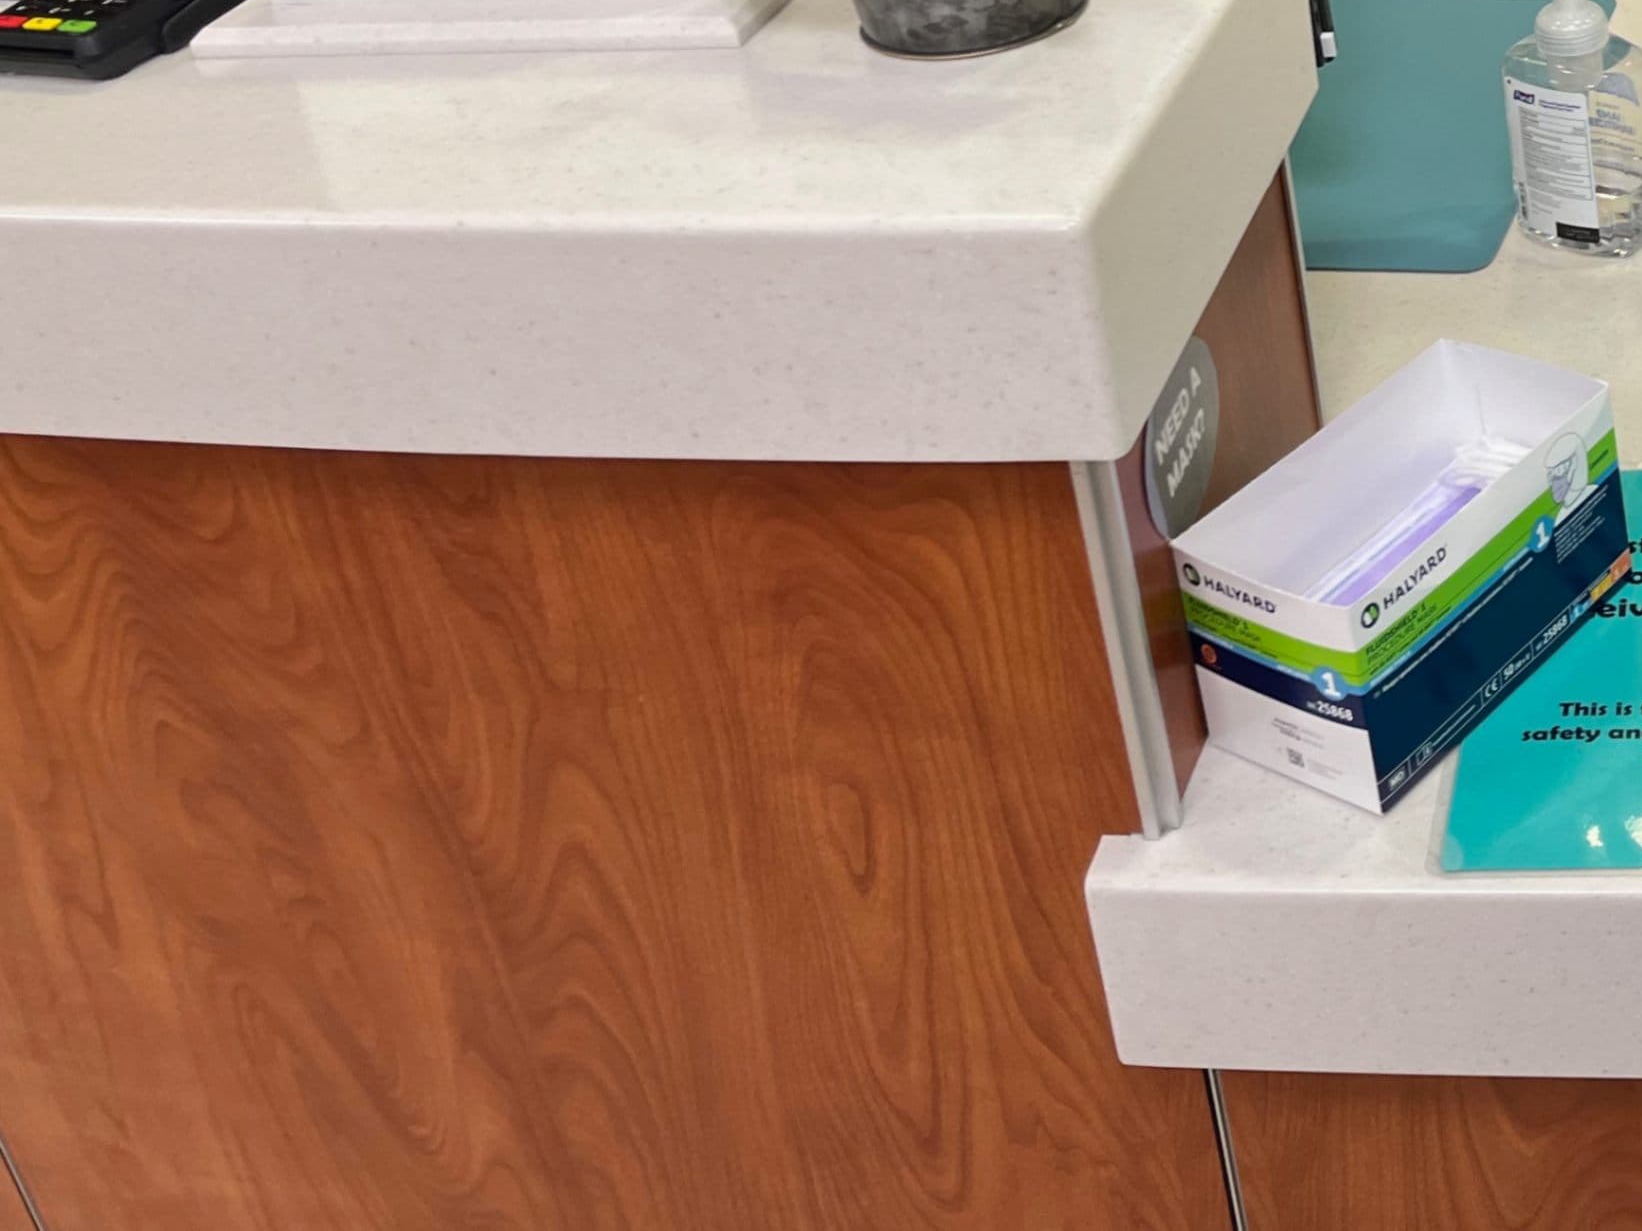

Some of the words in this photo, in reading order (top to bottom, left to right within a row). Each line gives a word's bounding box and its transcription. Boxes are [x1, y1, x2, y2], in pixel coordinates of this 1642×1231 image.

[1155, 388, 1190, 466] NEED
[1190, 367, 1201, 397] A
[1167, 407, 1205, 498] MASK?
[1536, 521, 1549, 549] 1
[1203, 574, 1277, 614] HALYARD
[1383, 547, 1447, 610] HALYARD
[1321, 672, 1341, 697] 1
[1559, 702, 1609, 718] This
[1615, 701, 1633, 717] is
[1521, 725, 1601, 744] safety
